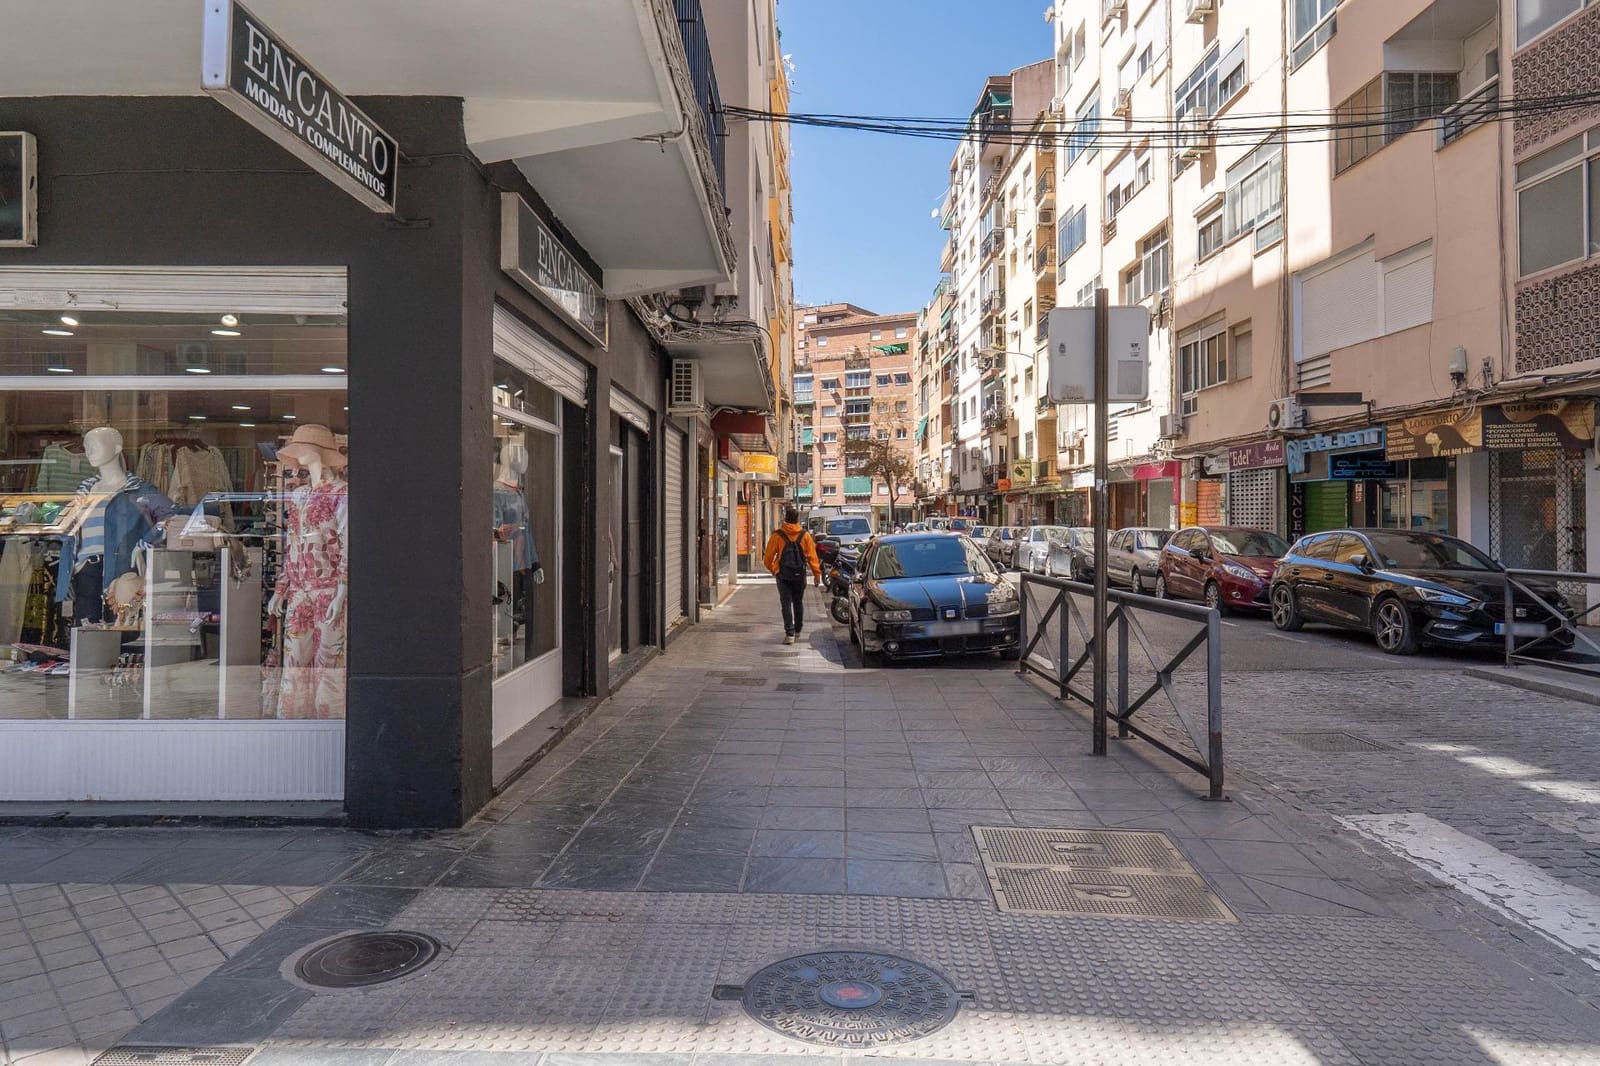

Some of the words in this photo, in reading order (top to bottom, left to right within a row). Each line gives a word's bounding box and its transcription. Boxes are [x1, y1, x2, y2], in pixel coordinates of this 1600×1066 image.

[244, 20, 388, 175] ENCANTO
[245, 77, 295, 127] MODAS
[296, 115, 305, 135] Y
[306, 125, 386, 198] COMPLEMENTOS
[537, 226, 596, 316] ENCANTO
[1409, 413, 1460, 430] LOCUTORIO
